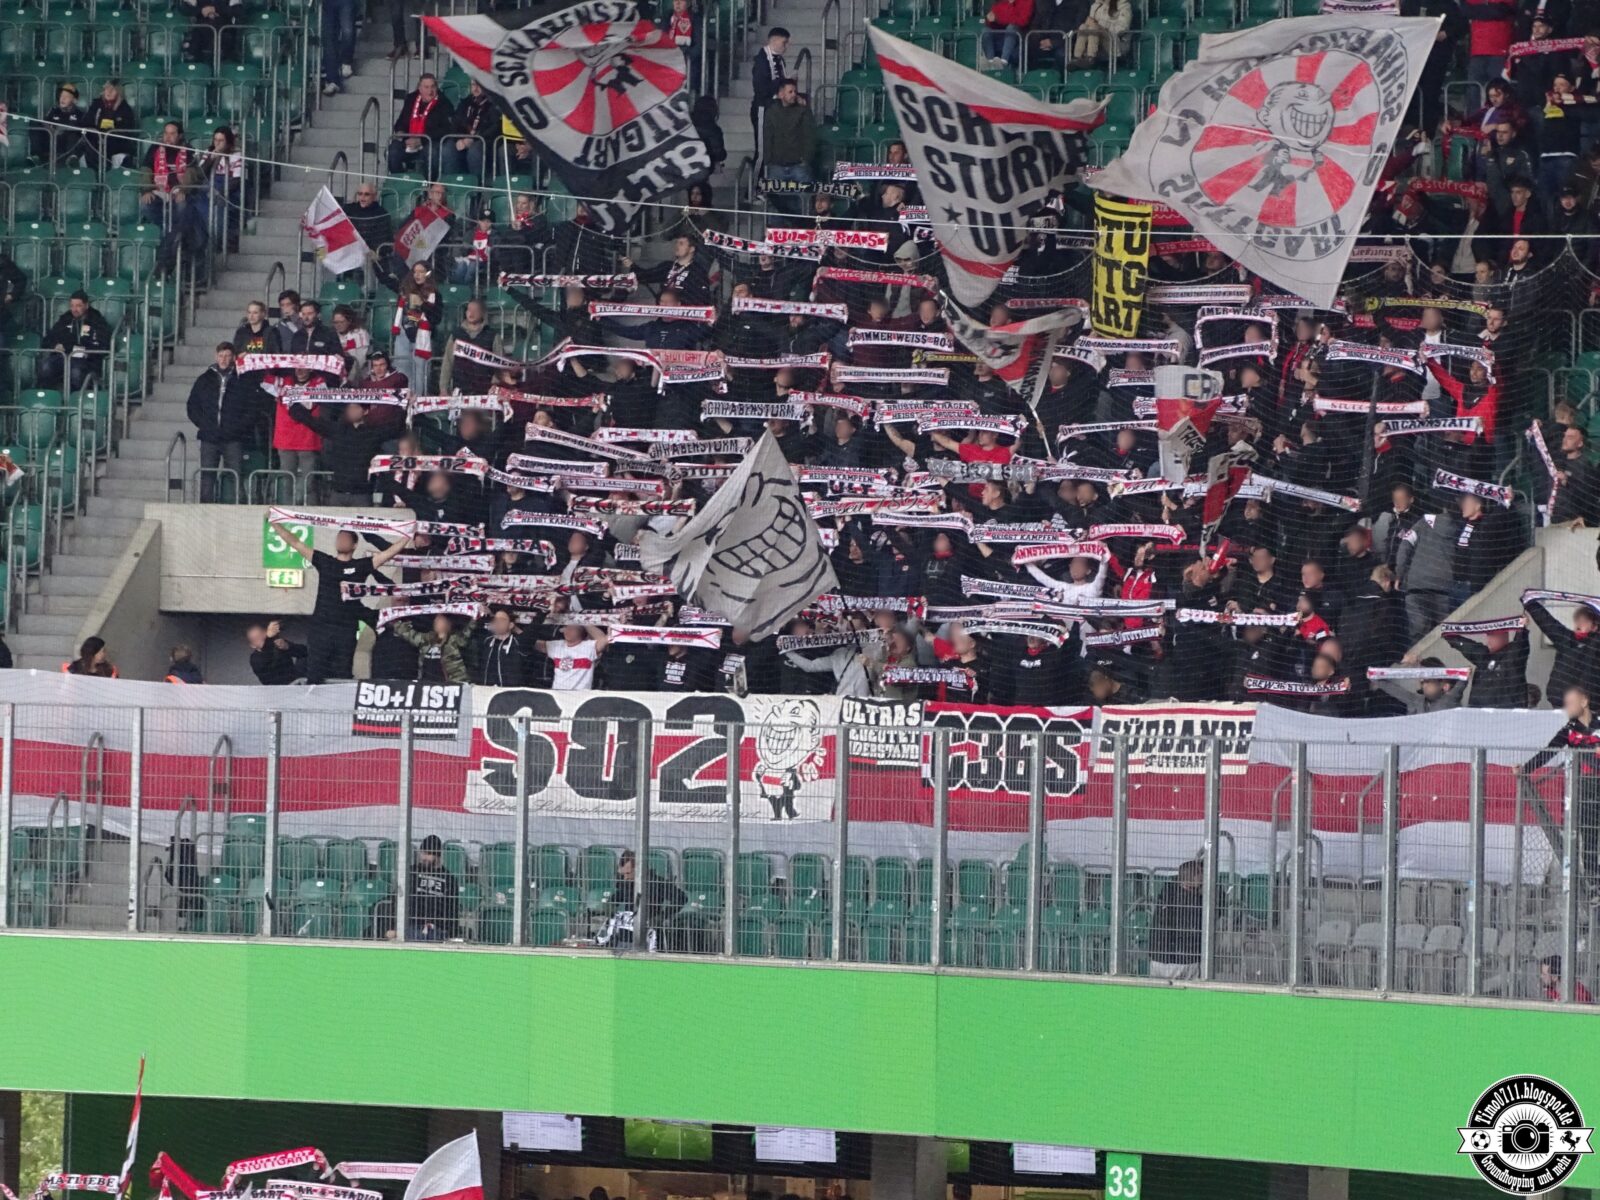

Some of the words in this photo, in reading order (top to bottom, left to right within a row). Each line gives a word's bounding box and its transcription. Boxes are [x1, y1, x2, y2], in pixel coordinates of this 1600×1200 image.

[420, 685, 461, 709] IST
[841, 698, 922, 727] ULTRAS
[1099, 717, 1254, 754] SÜDBANDE
[1108, 1165, 1138, 1198] 33
